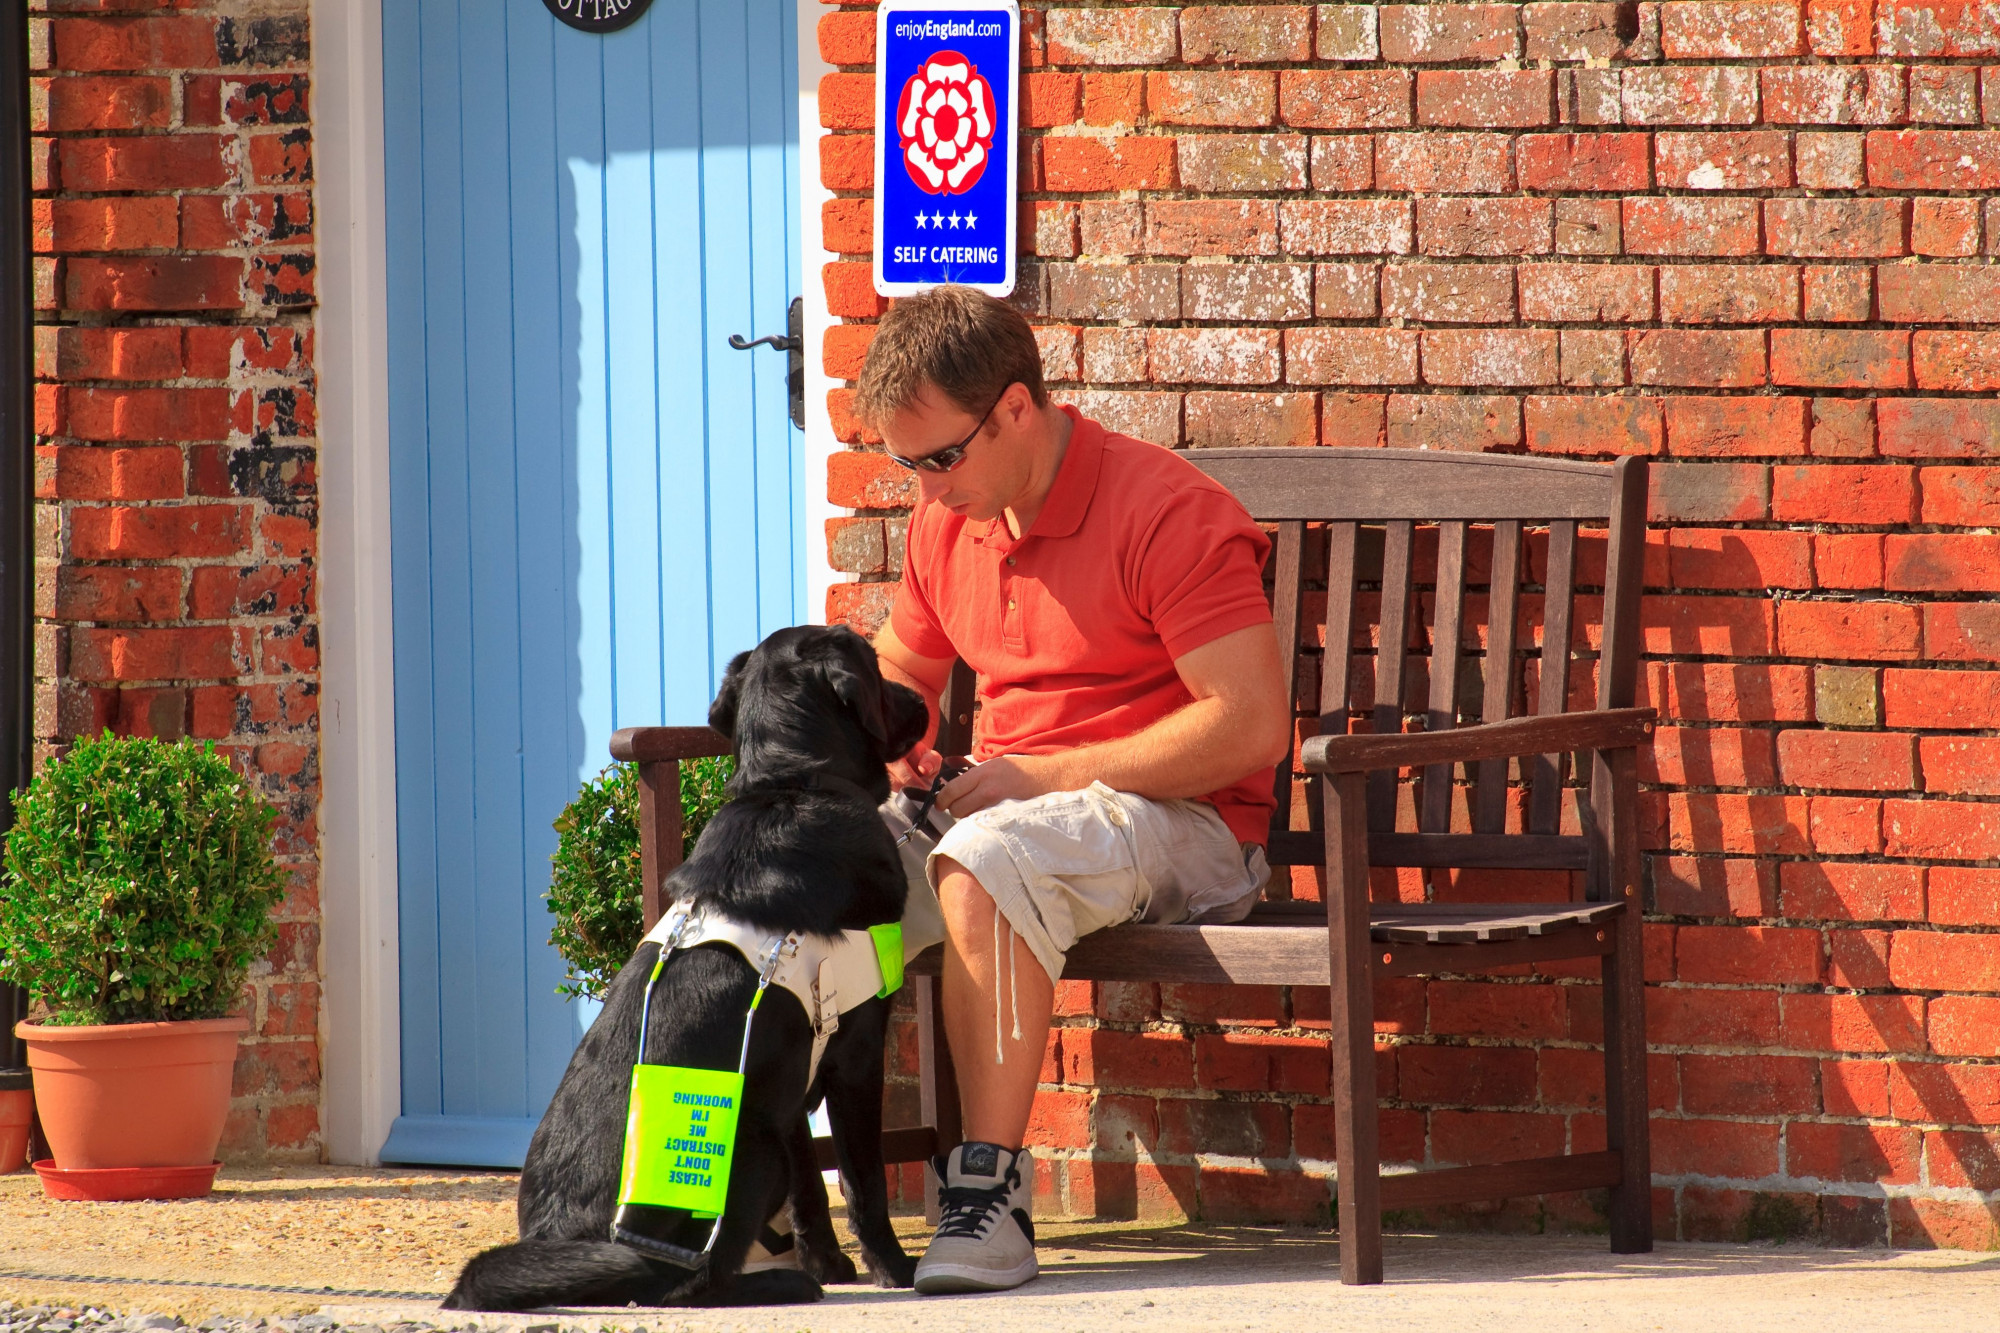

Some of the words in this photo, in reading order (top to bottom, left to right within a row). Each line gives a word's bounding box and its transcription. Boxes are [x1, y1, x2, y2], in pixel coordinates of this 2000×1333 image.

[896, 19, 1001, 40] enjoyEngland.com
[894, 246, 927, 263] SELF
[931, 247, 998, 264] CATERING
[673, 1092, 733, 1109] WORKING
[691, 1109, 710, 1122] I'M
[688, 1124, 707, 1137] ME
[664, 1138, 726, 1157] DISTRACT
[674, 1155, 711, 1171] DON'T
[668, 1170, 712, 1187] PLEASE
